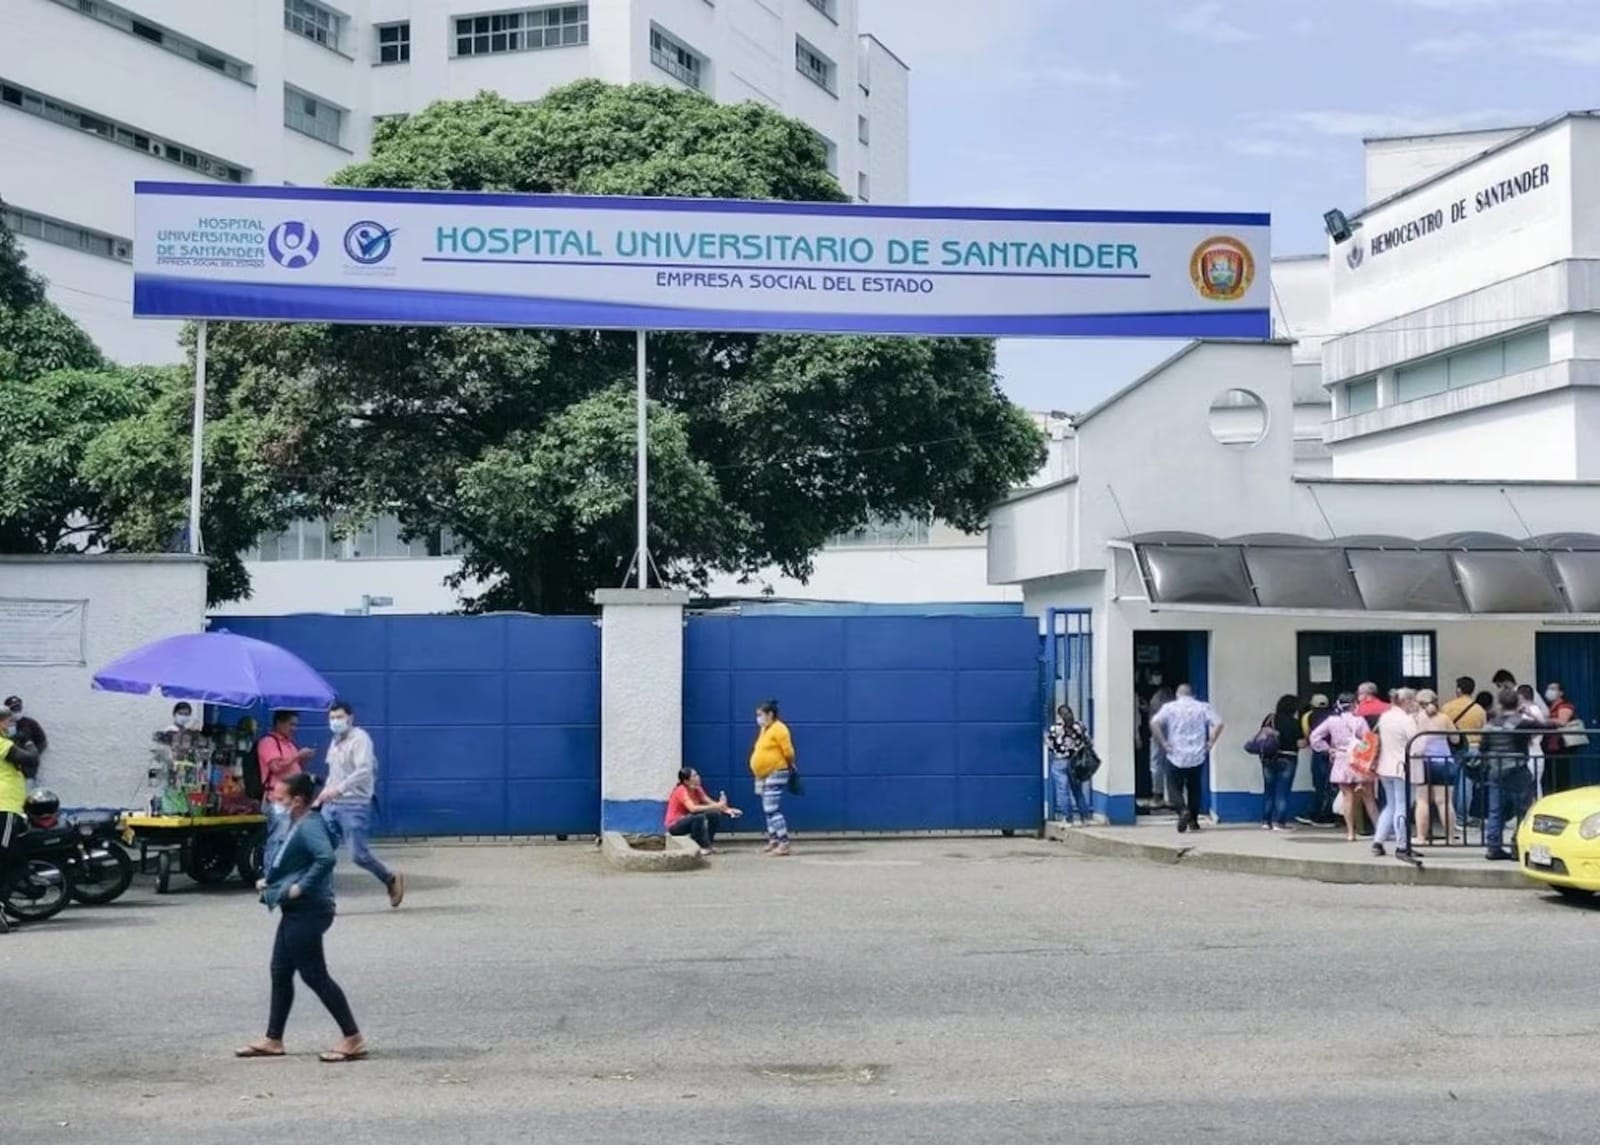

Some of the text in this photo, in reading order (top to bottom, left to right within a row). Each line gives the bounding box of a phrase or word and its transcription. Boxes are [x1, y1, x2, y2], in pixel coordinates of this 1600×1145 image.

[1371, 163, 1549, 256] HEMOCENTRO DE SANTANDER
[198, 217, 265, 231] HOSPITAL
[157, 230, 265, 245] UNIVERSITARIO
[157, 244, 265, 259] DE SANTANDER
[436, 226, 1138, 269] HOSPITAL UNIVERSITARIO DE SANTANDER
[656, 271, 934, 294] EMPRESA SOCIAL DEL ESTADO
